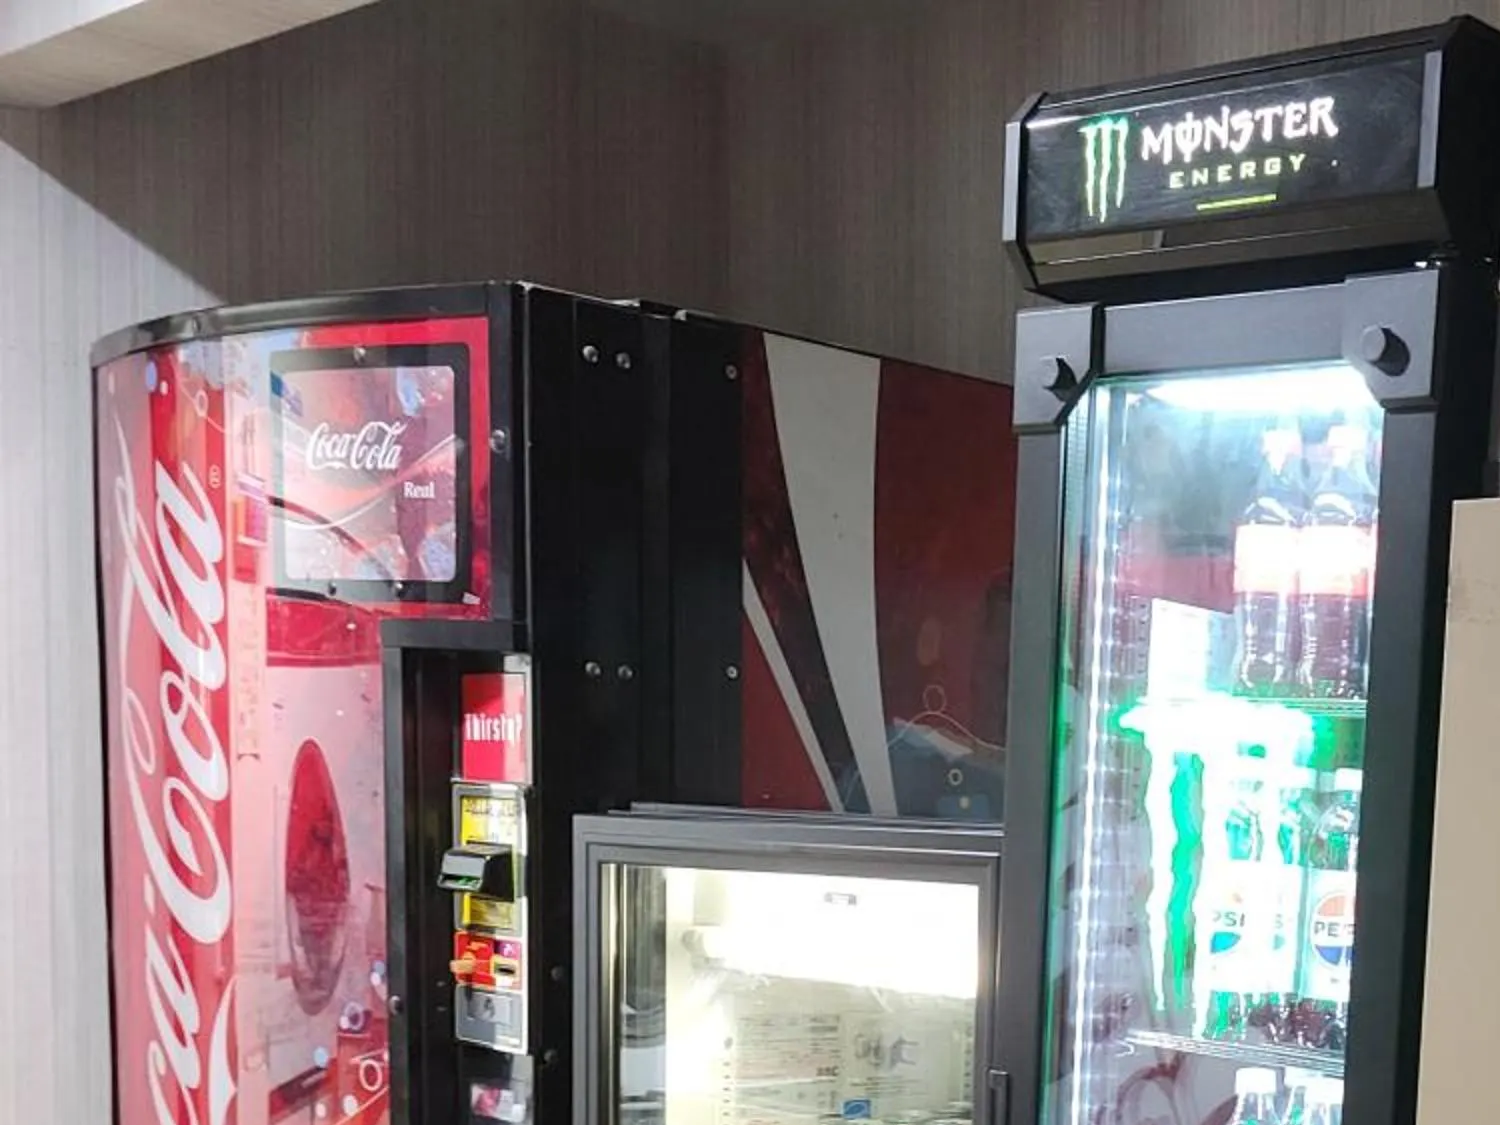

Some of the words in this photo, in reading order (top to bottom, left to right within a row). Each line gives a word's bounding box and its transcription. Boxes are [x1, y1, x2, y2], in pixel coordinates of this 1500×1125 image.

[1140, 96, 1339, 166] MONSTER
[1168, 153, 1306, 190] ENERGY
[305, 421, 408, 471] Coca-Cola
[403, 481, 436, 499] Real
